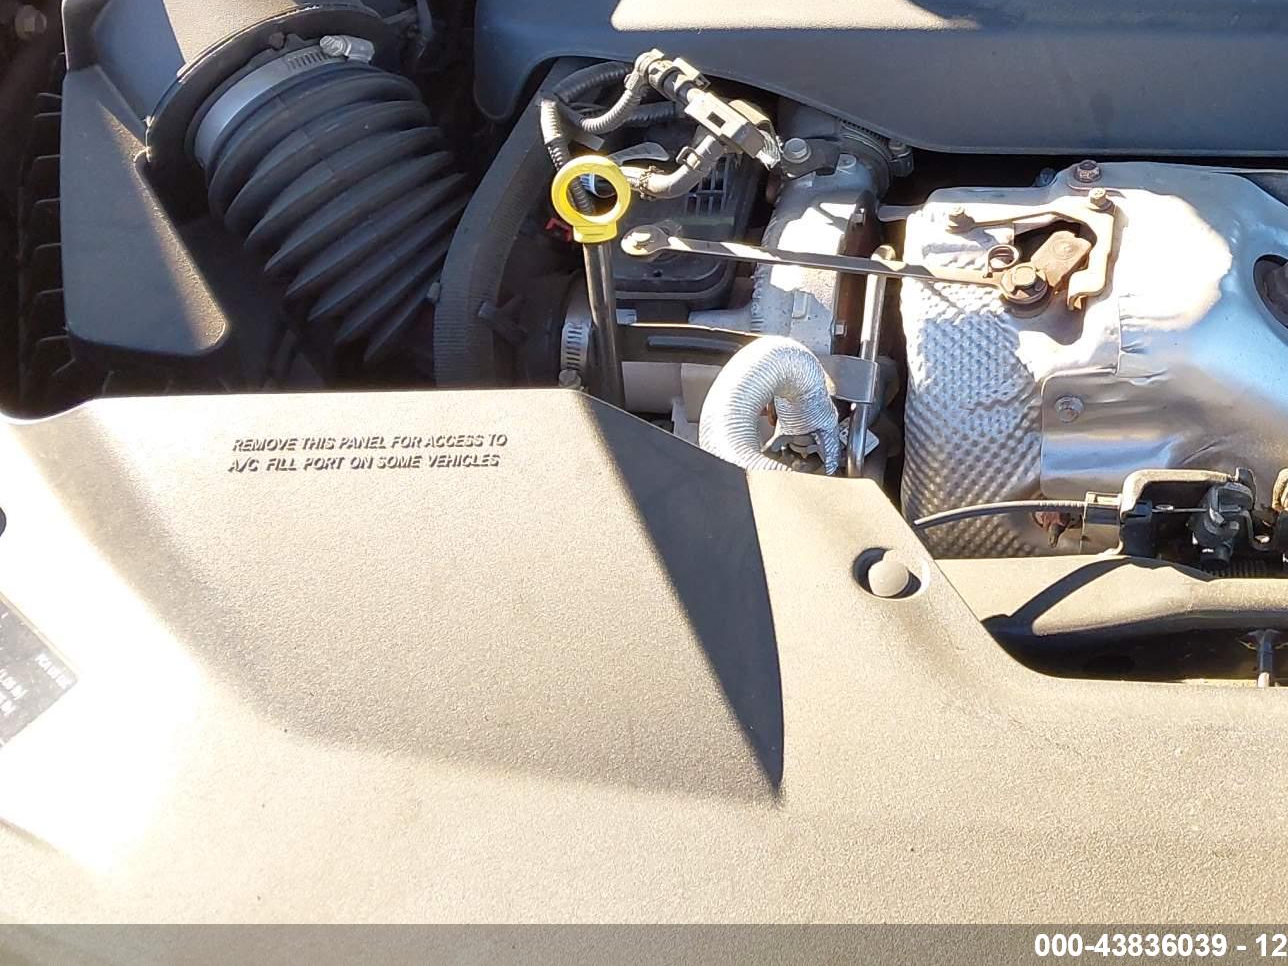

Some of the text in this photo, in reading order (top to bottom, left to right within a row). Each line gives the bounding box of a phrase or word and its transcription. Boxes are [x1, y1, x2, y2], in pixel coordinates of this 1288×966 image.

[232, 433, 508, 452] REMOVE THIS PANEL FOR ACCESS TO
[228, 453, 501, 473] A/C FILL PORT ON SOME VEHICLES
